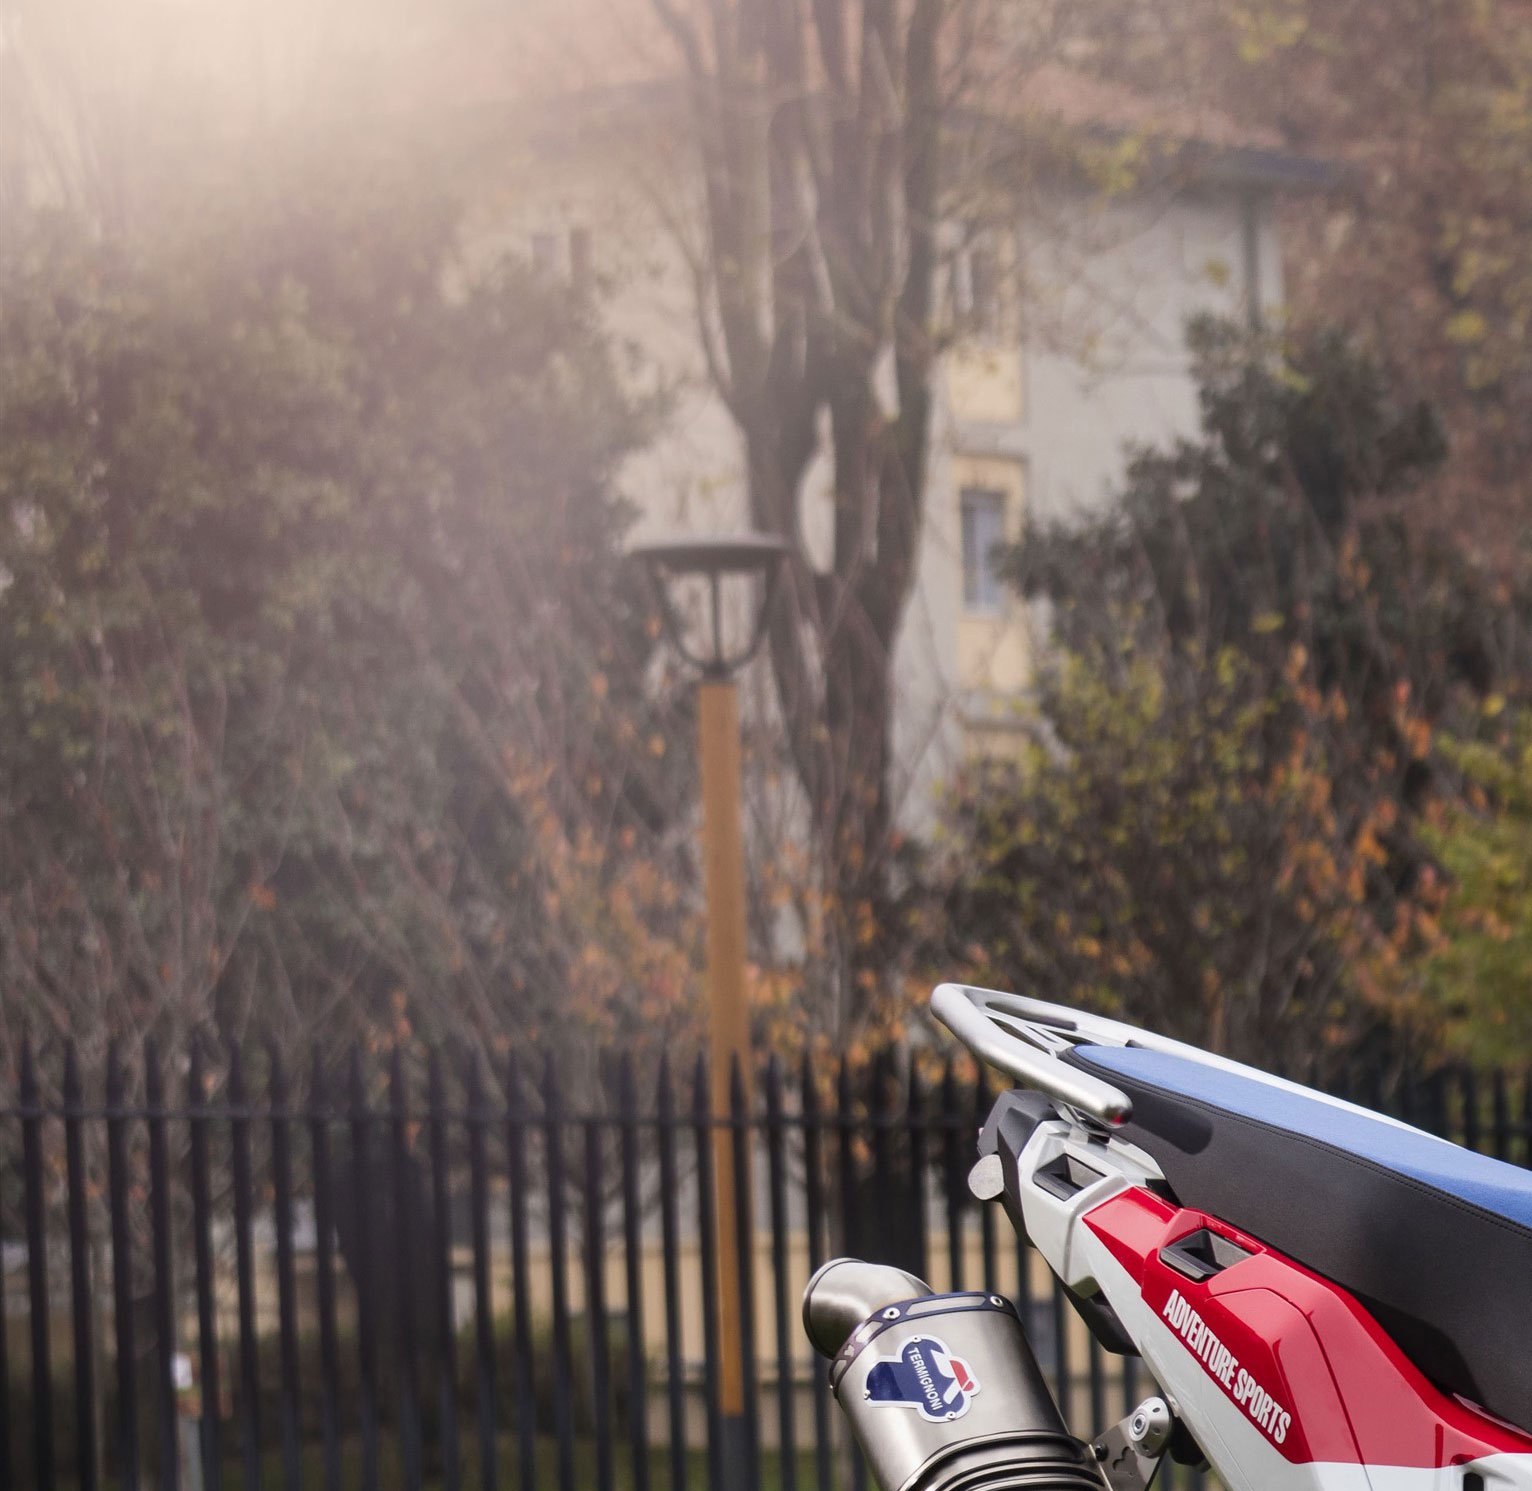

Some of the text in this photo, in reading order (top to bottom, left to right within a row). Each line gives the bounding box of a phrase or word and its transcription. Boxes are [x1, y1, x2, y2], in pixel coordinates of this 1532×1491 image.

[905, 1346, 943, 1413] TERMIGNONI
[1162, 1289, 1293, 1445] ADVENTURE SPORTS
